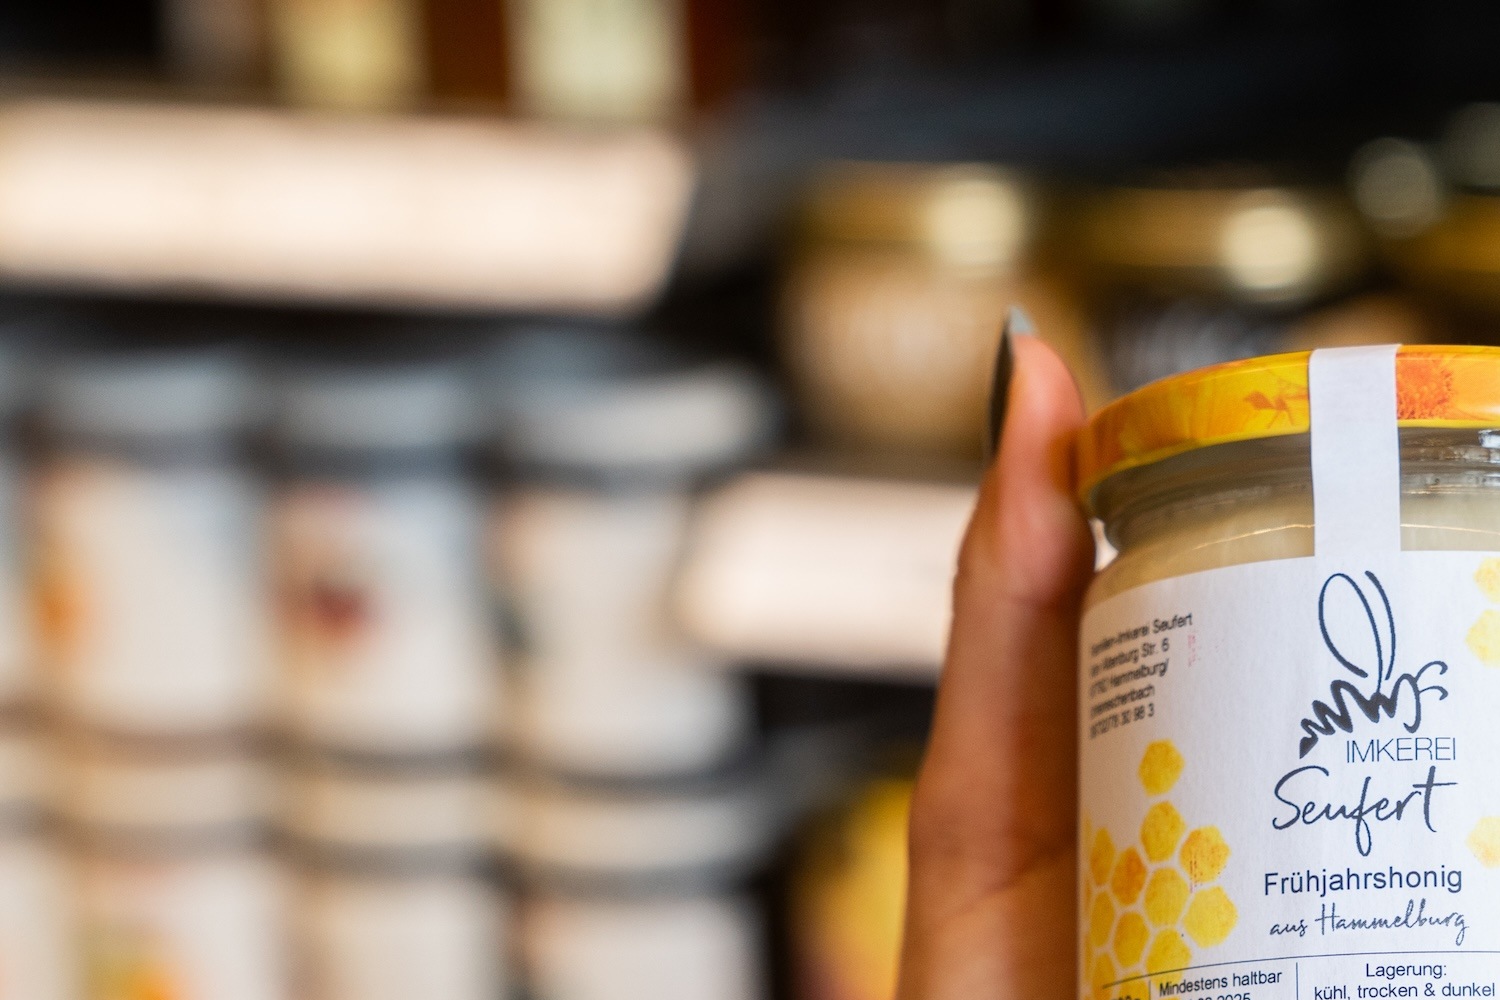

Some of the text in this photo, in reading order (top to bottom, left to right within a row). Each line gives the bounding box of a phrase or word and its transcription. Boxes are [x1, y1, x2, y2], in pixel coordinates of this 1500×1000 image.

[1346, 737, 1456, 763] IMKEREI
[1272, 765, 1458, 857] Seufert
[1264, 865, 1462, 898] Frühjahrshonig
[1269, 898, 1470, 946] aus Hammelburg
[1159, 970, 1282, 998] Mindestens haltbar
[1365, 962, 1447, 980] Lagerung:
[1357, 982, 1418, 999] trocken
[1424, 982, 1436, 997] &
[1441, 981, 1496, 997] dunkel
